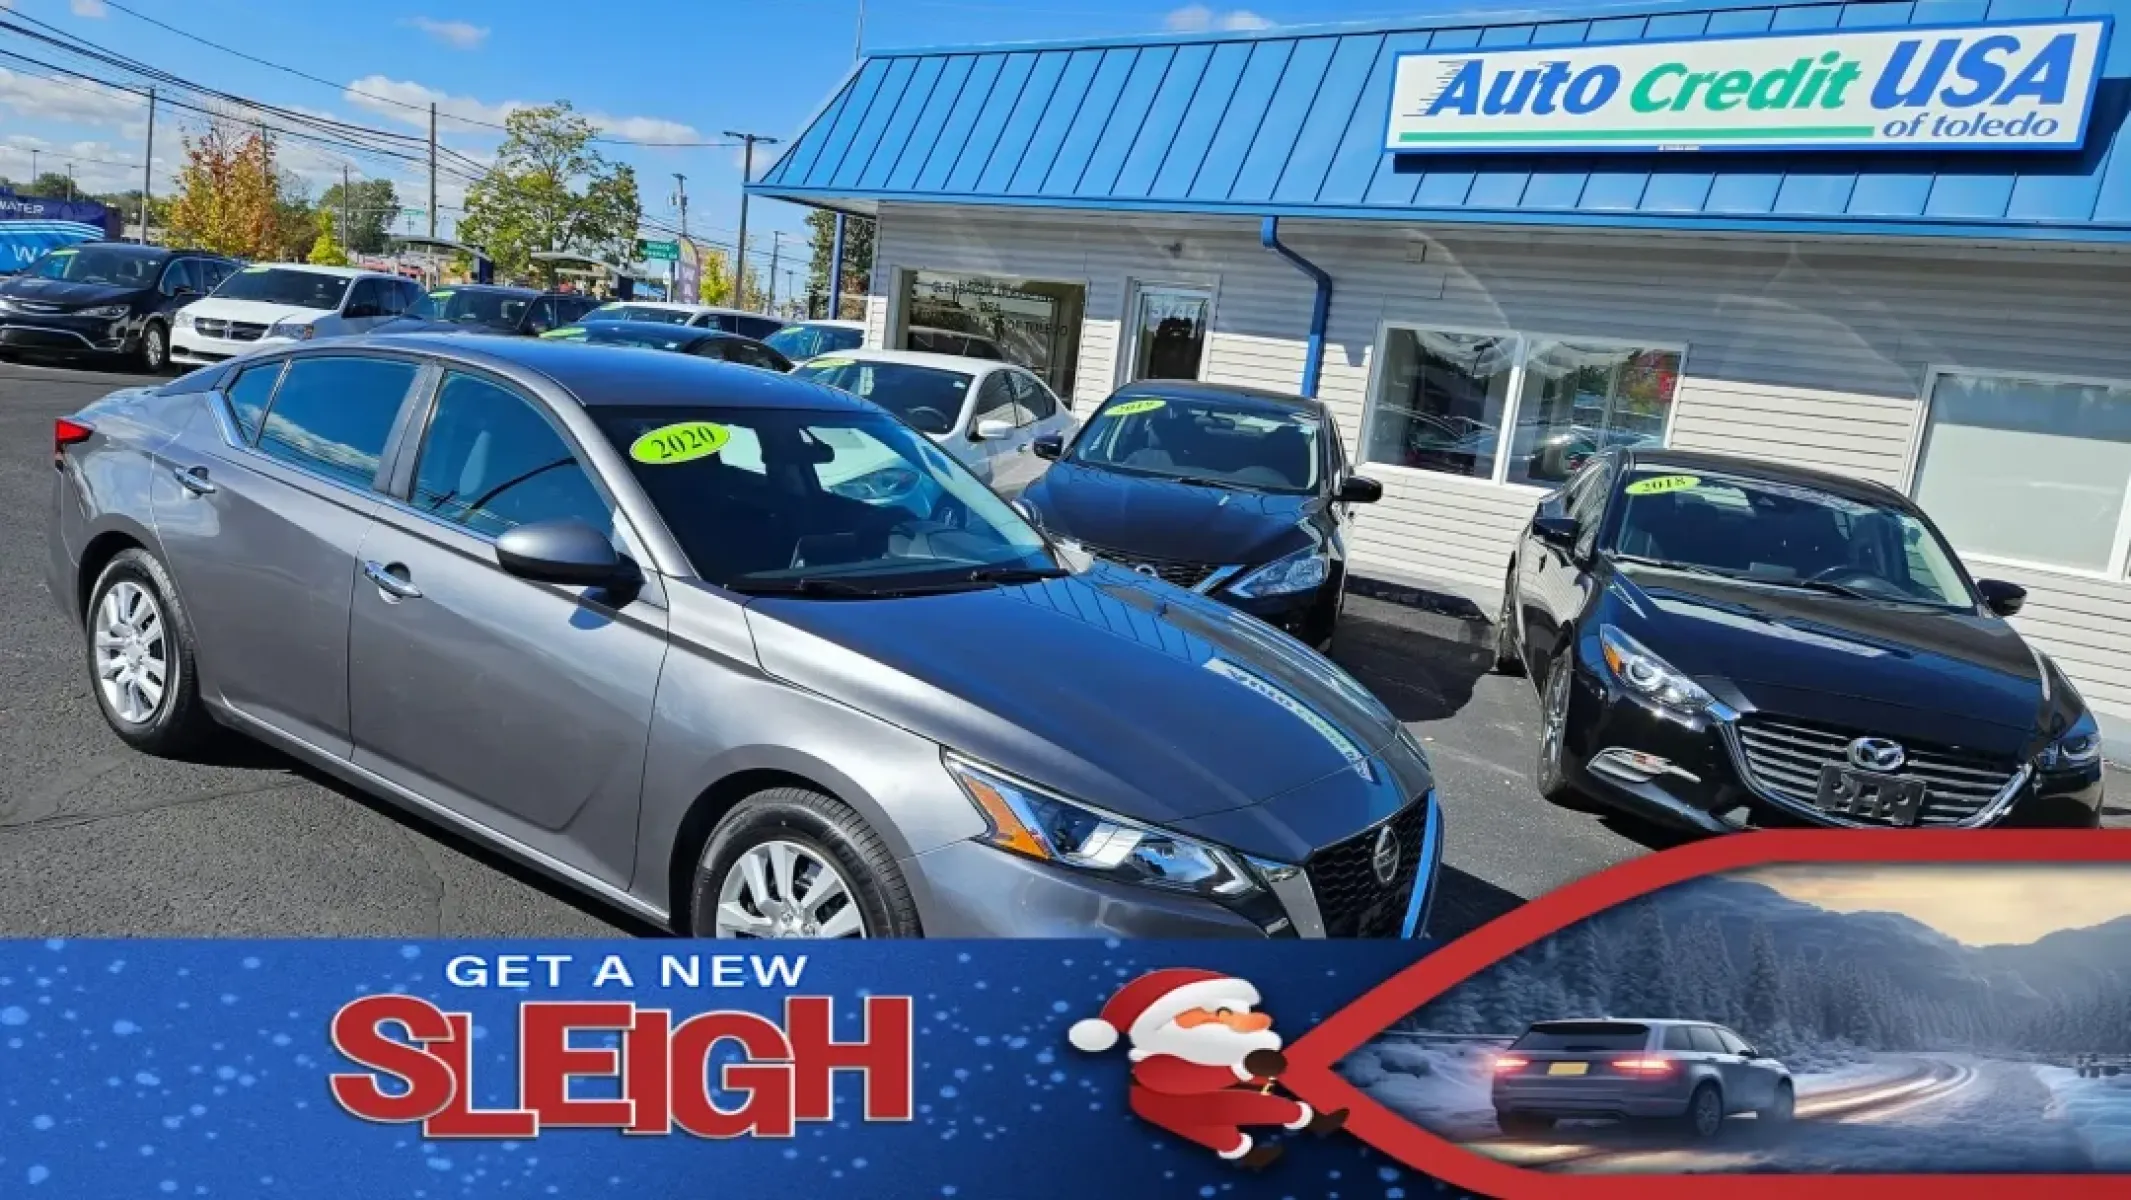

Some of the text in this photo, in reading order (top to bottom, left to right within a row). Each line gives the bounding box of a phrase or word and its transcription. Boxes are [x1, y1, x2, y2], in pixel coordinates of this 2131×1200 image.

[1424, 33, 2077, 116] Auto Credit USA
[1883, 110, 2059, 137] of toledo
[651, 426, 716, 459] 2020
[1641, 476, 1686, 492] 2018
